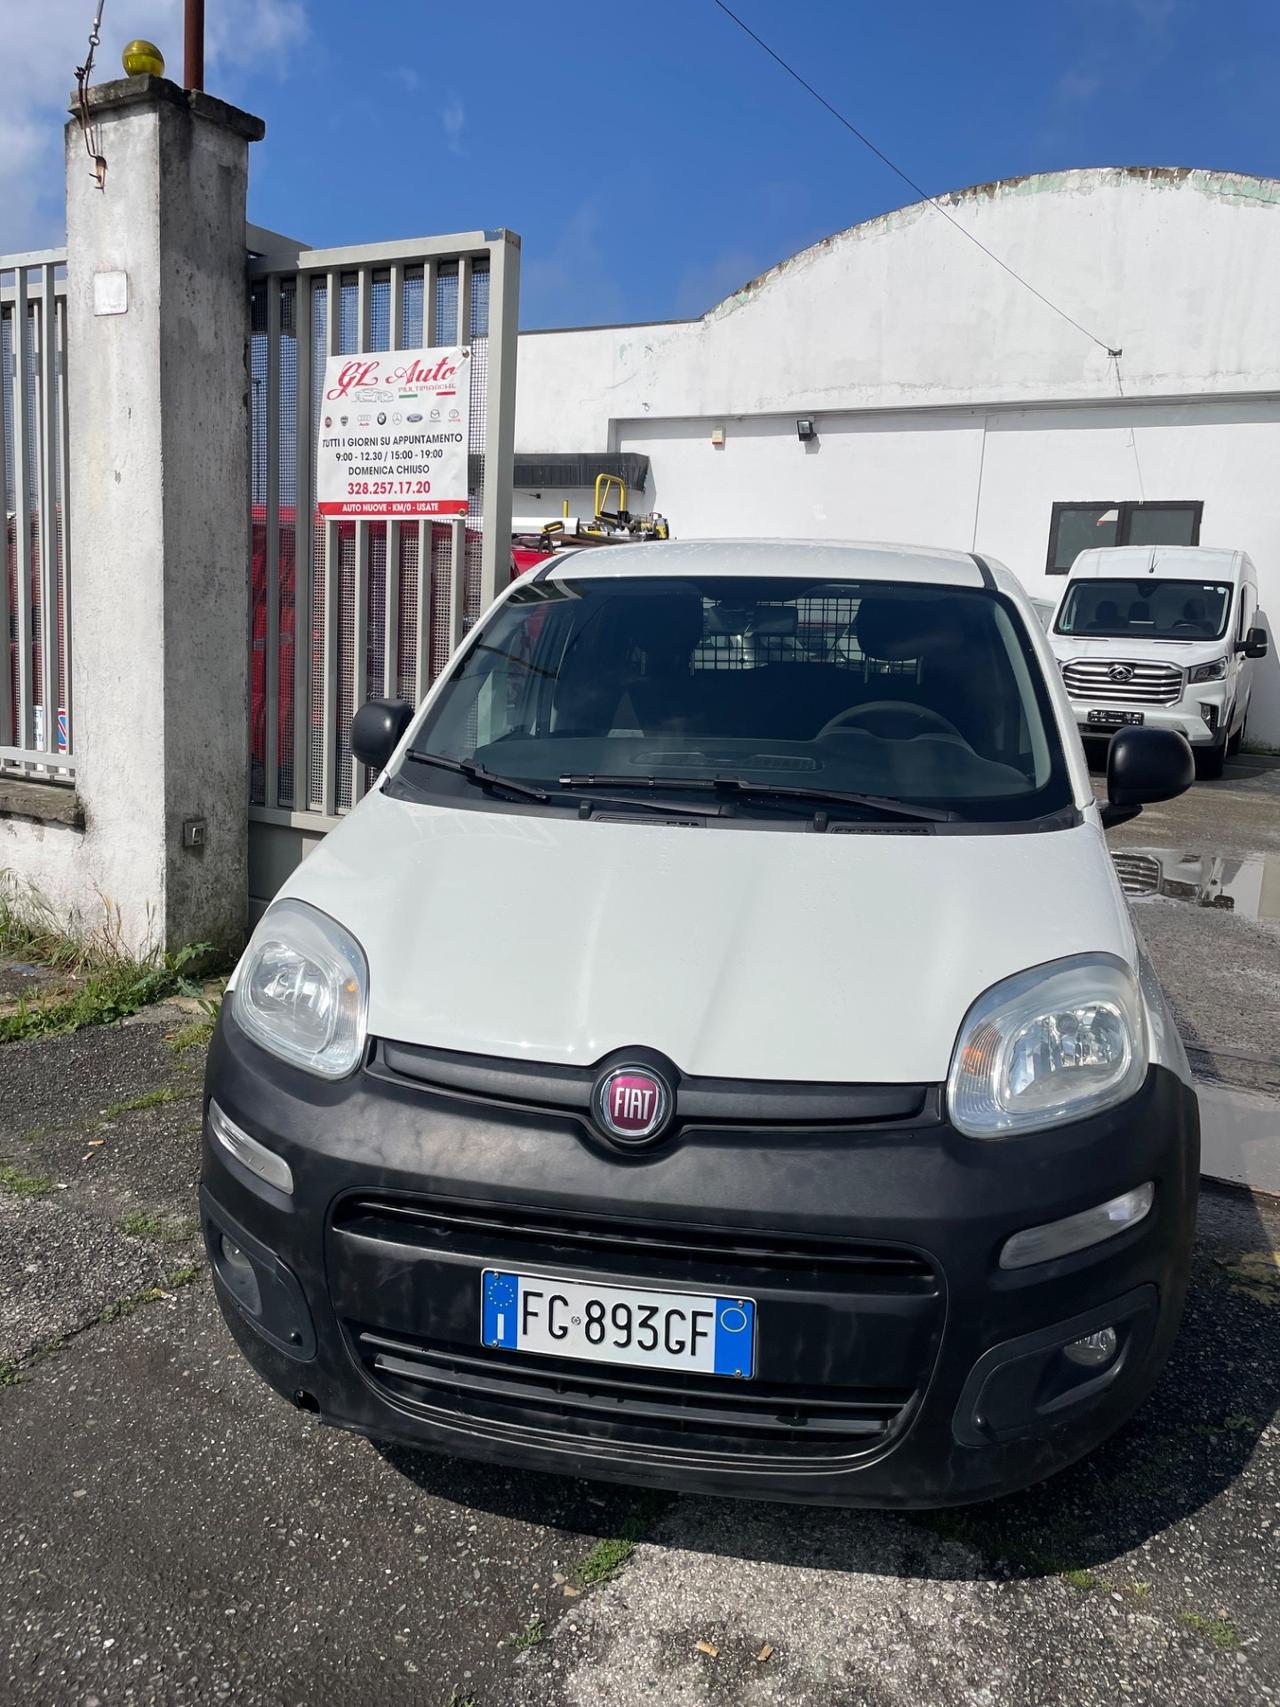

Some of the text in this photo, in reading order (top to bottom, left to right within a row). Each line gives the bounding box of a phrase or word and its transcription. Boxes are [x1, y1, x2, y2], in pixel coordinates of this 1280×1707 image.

[385, 356, 457, 385] Auto
[322, 433, 463, 448] TUTTI I GIORNI SU APPUNTAMENTO
[335, 452, 353, 462] 9:00
[361, 451, 383, 461] 12.30
[391, 450, 413, 460] 15:00
[421, 449, 443, 459] 19:00
[348, 464, 430, 476] DOMENICA CHIUSO
[347, 481, 431, 495] 328.257.17.20
[342, 503, 361, 512] AUTO
[362, 503, 387, 512] NUOVE
[416, 502, 439, 511] USATE
[614, 1087, 653, 1120] FIAT
